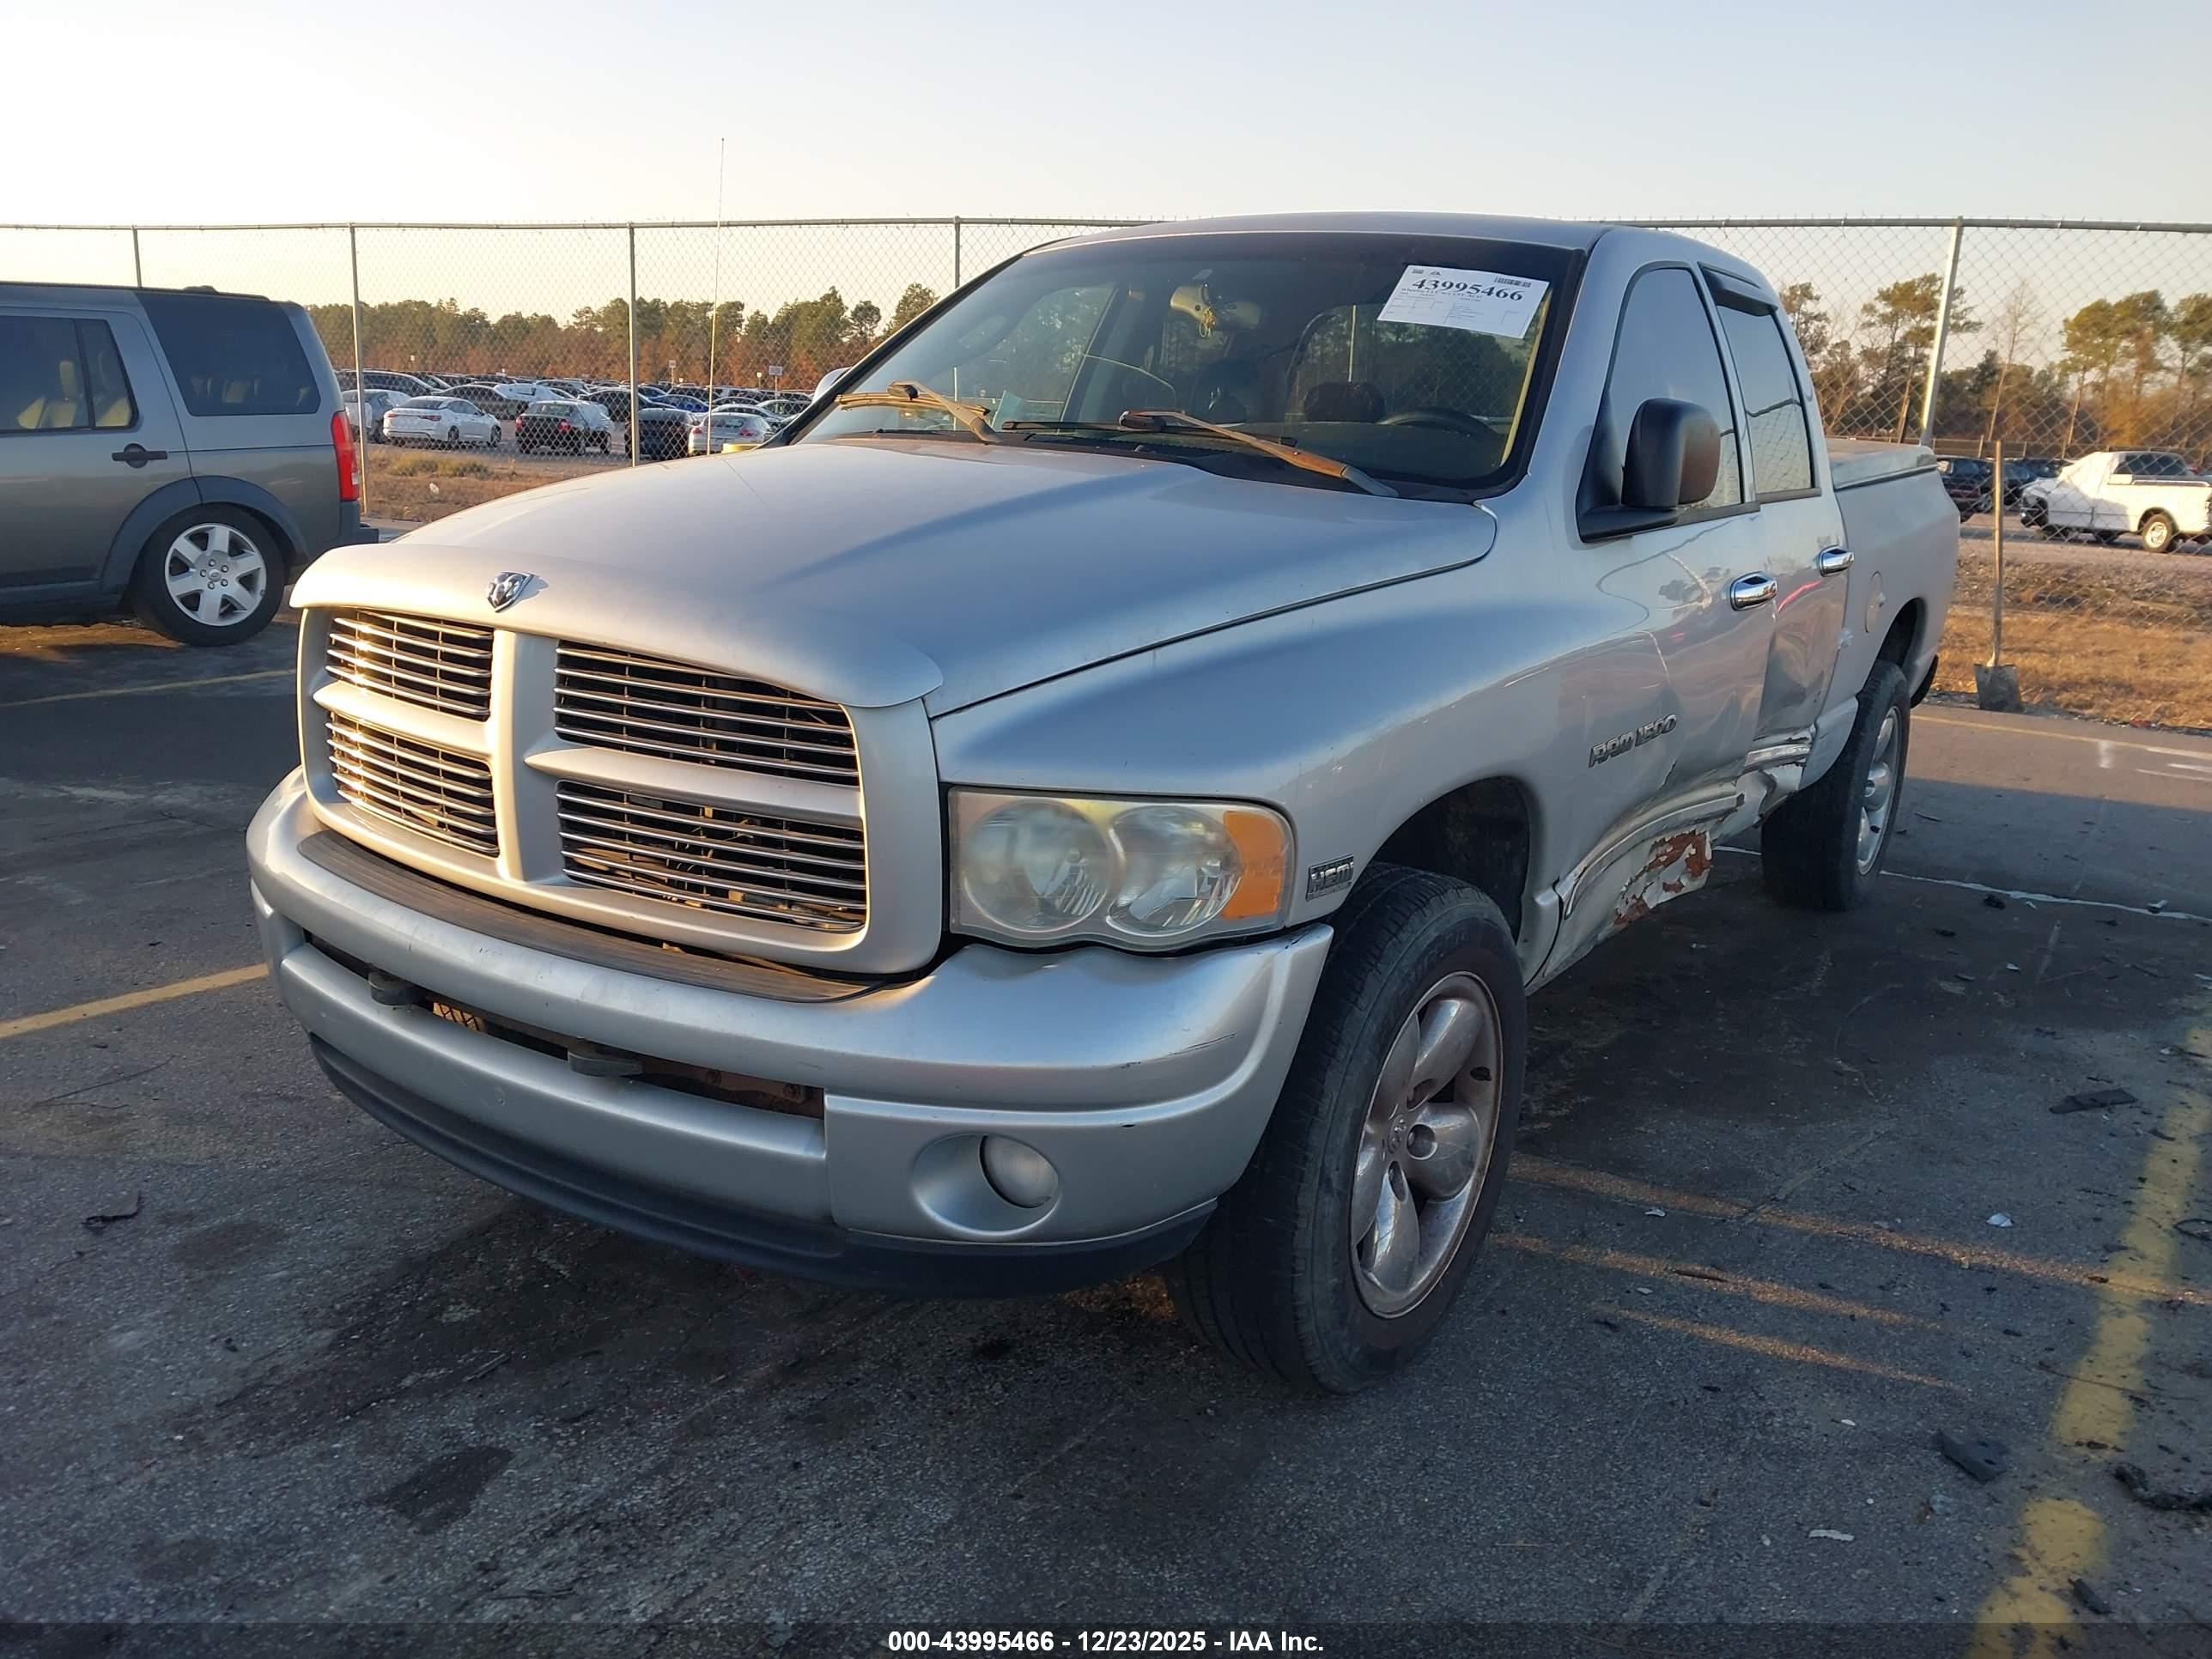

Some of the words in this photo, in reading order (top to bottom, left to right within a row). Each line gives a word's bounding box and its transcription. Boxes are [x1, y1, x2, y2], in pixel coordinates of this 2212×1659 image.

[1412, 278, 1525, 301] 43995466
[1589, 732, 1634, 768] RAM
[1635, 714, 1677, 746] 1500
